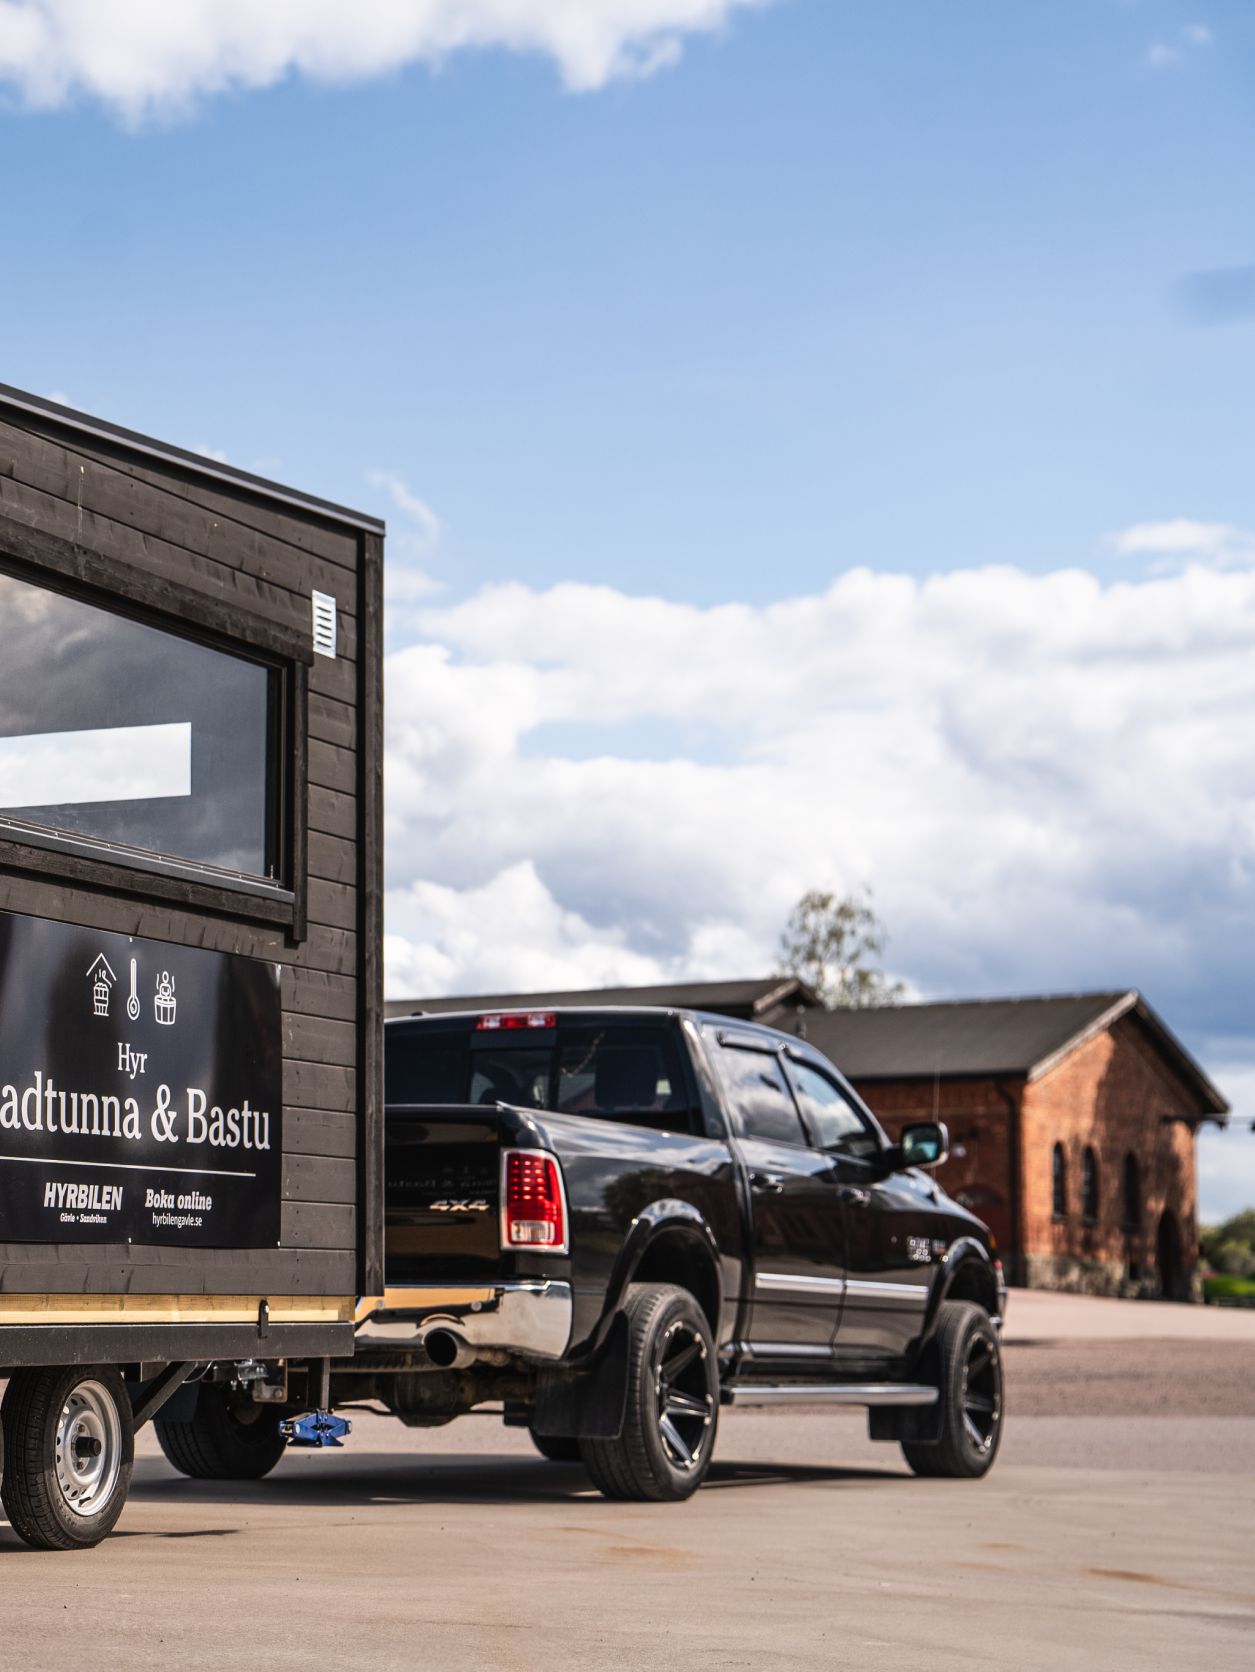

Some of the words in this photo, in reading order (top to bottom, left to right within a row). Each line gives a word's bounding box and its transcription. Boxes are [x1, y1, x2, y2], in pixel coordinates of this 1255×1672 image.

[117, 1042, 148, 1079] Hyr
[150, 1083, 179, 1143] &
[186, 1087, 271, 1150] Bastu
[43, 1182, 124, 1211] HYRBILEN
[145, 1188, 175, 1210] Boka
[177, 1191, 213, 1211] online
[152, 1212, 203, 1229] hyrbilengavle.se
